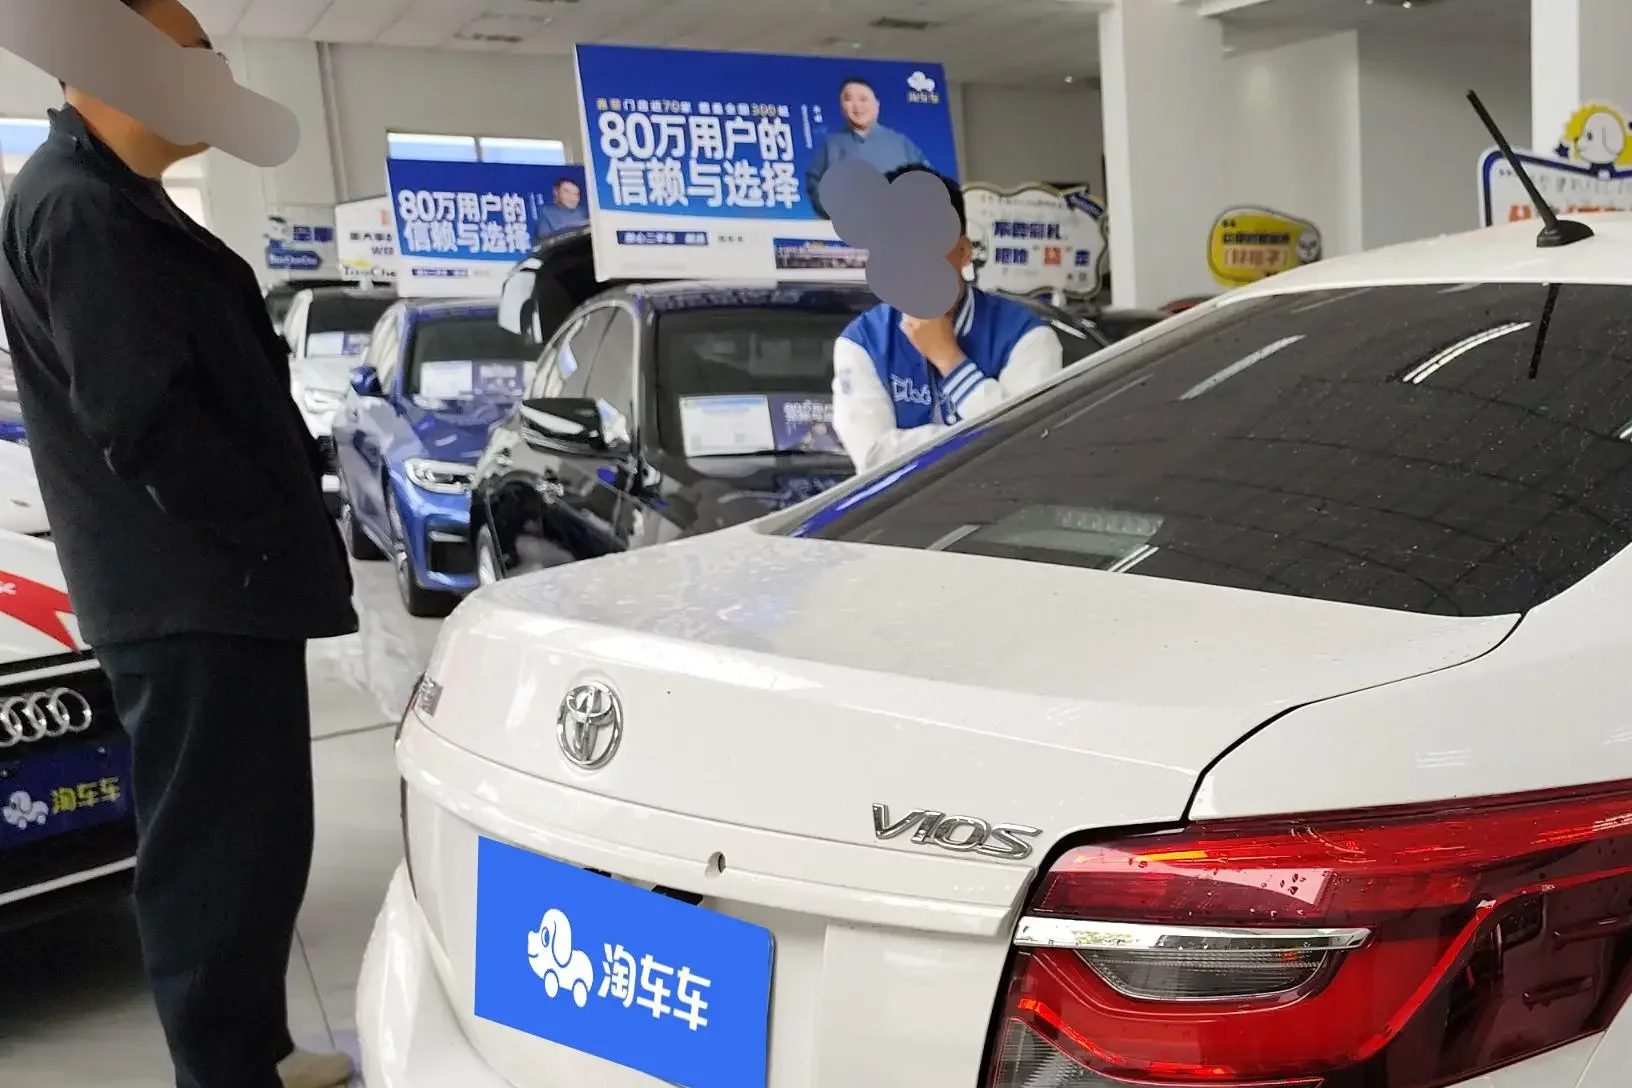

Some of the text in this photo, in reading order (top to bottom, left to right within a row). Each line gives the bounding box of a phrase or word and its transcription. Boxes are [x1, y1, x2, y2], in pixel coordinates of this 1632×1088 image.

[598, 111, 795, 161] 80万用户的
[397, 189, 527, 223] 80万用户的
[605, 156, 800, 208] 信赖与选择
[402, 219, 532, 254] 信赖与选择
[871, 802, 1044, 861] VIOS
